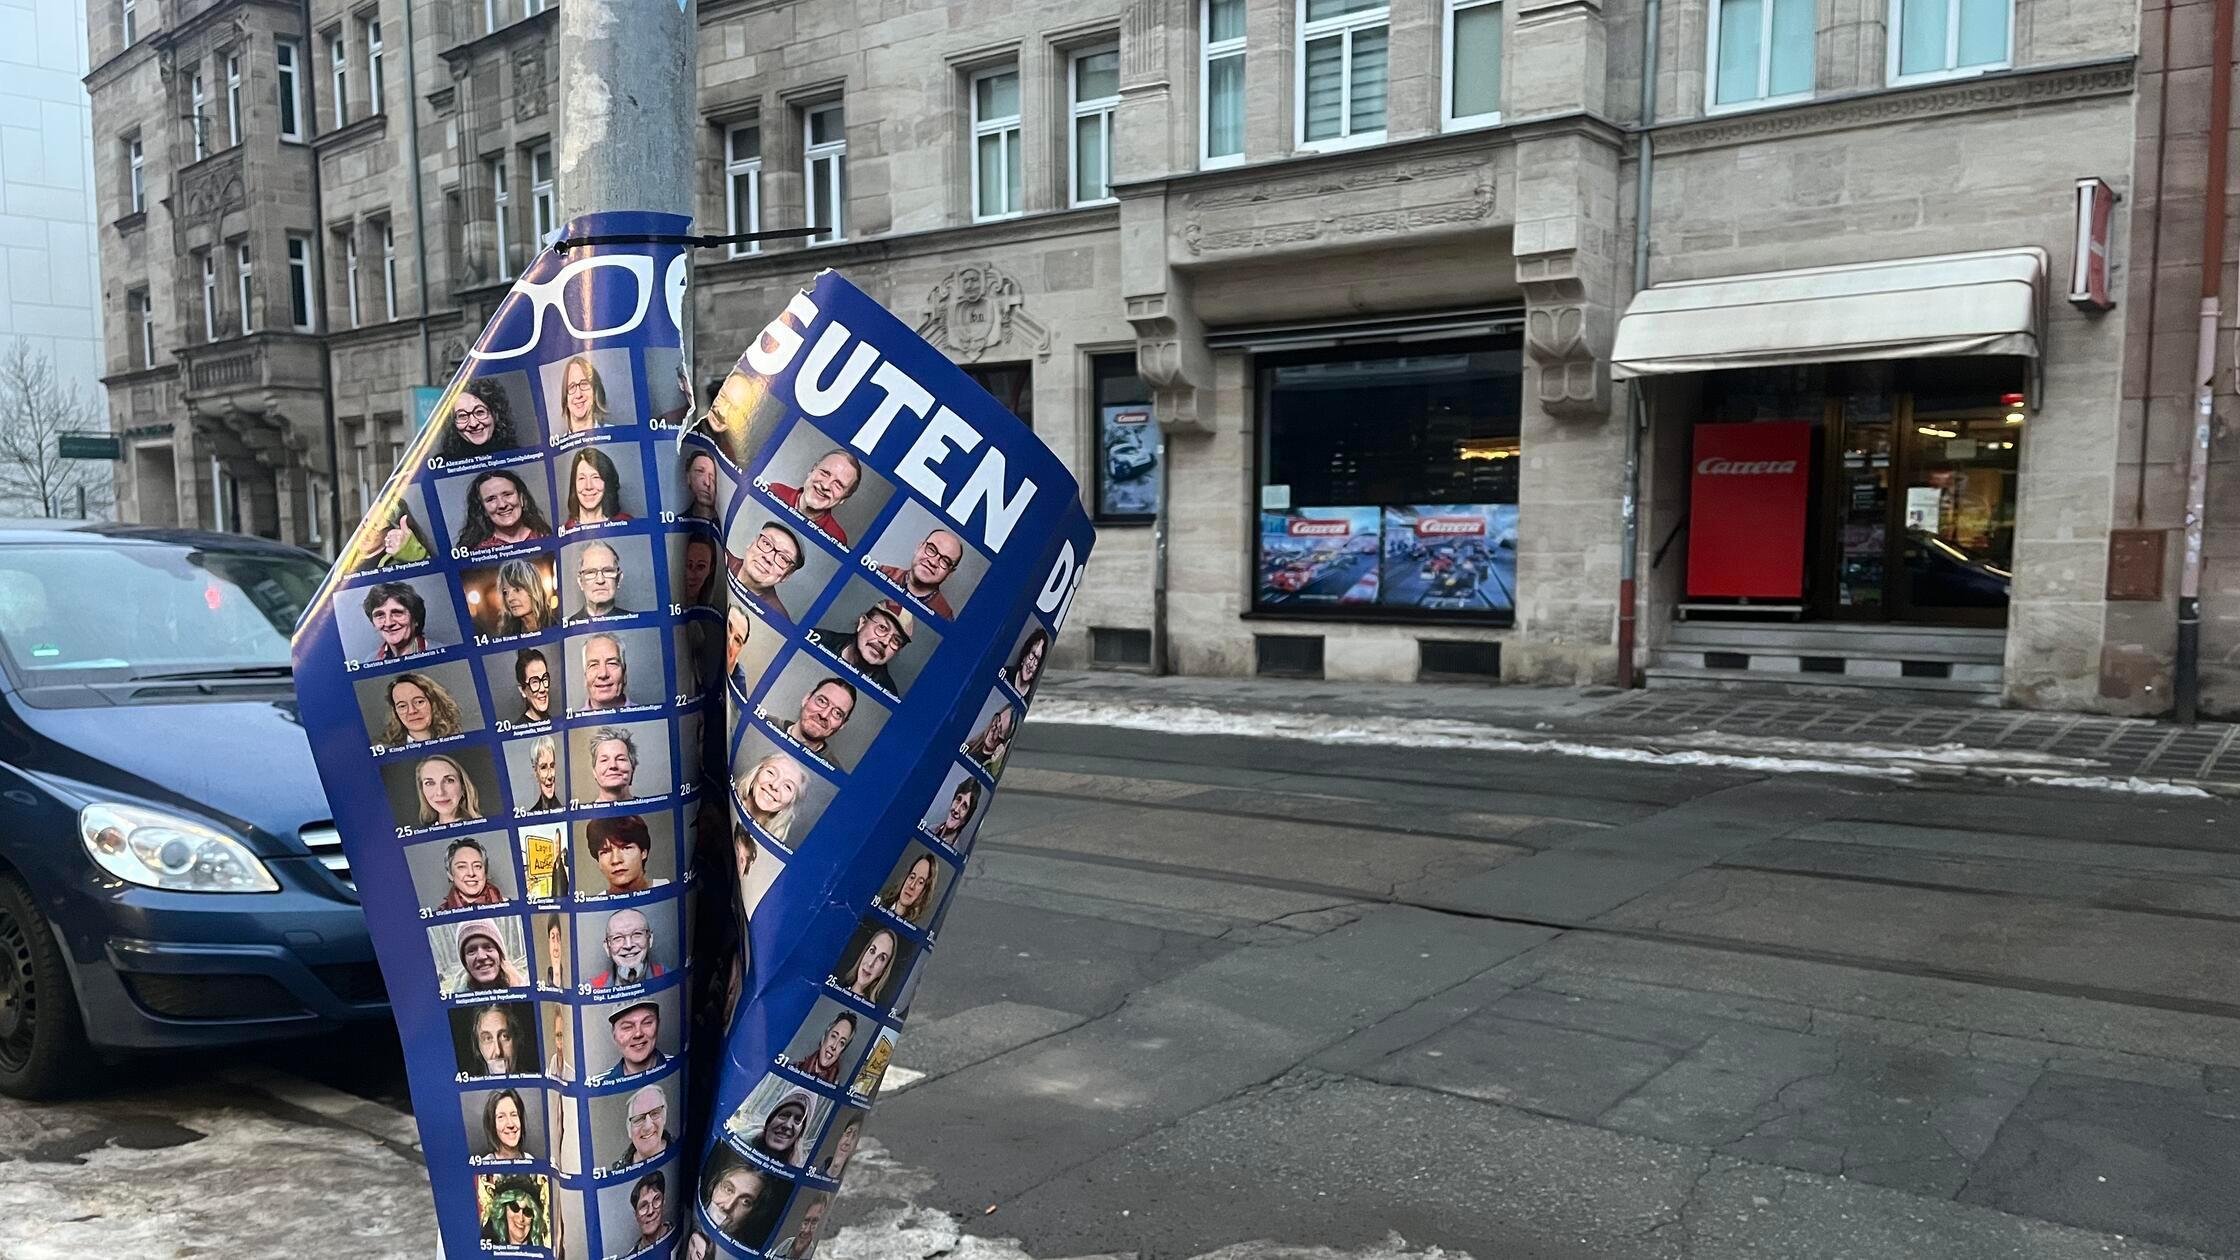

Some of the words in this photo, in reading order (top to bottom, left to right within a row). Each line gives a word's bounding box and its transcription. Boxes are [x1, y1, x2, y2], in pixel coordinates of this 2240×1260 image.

[649, 418, 667, 431] 04
[745, 290, 1038, 554] GUTEN
[549, 435, 560, 448] 03
[427, 456, 446, 470] 02
[1697, 457, 1797, 474] Carrera
[752, 475, 771, 494] 05
[659, 511, 675, 524] 10
[1292, 521, 1348, 534] Carrera
[1421, 519, 1482, 533] Carrera
[450, 546, 470, 560] 08
[860, 554, 879, 573] 06
[669, 604, 682, 617] 16
[473, 635, 489, 647] 14
[804, 628, 822, 647] 12
[344, 659, 360, 673] 13
[675, 695, 688, 707] 22
[565, 708, 573, 720] 21
[753, 703, 767, 720] 18
[495, 720, 512, 733] 20
[369, 744, 386, 757] 19
[959, 743, 970, 755] 07
[680, 783, 691, 796] 28
[570, 798, 580, 811] 27
[513, 806, 527, 819] 26
[917, 818, 928, 831] 13
[395, 825, 413, 838] 25
[527, 893, 537, 905] 32
[574, 890, 585, 903] 33
[870, 894, 881, 907] 19
[418, 906, 434, 920] 31
[536, 980, 546, 992] 38
[825, 974, 838, 988] 25
[578, 984, 592, 996] 39
[774, 1053, 789, 1068] 31
[455, 1071, 470, 1084] 43
[584, 1075, 601, 1088] 45
[468, 1155, 483, 1167] 49
[592, 1167, 608, 1180] 51
[806, 1165, 816, 1178] 38
[480, 1239, 492, 1250] 55
